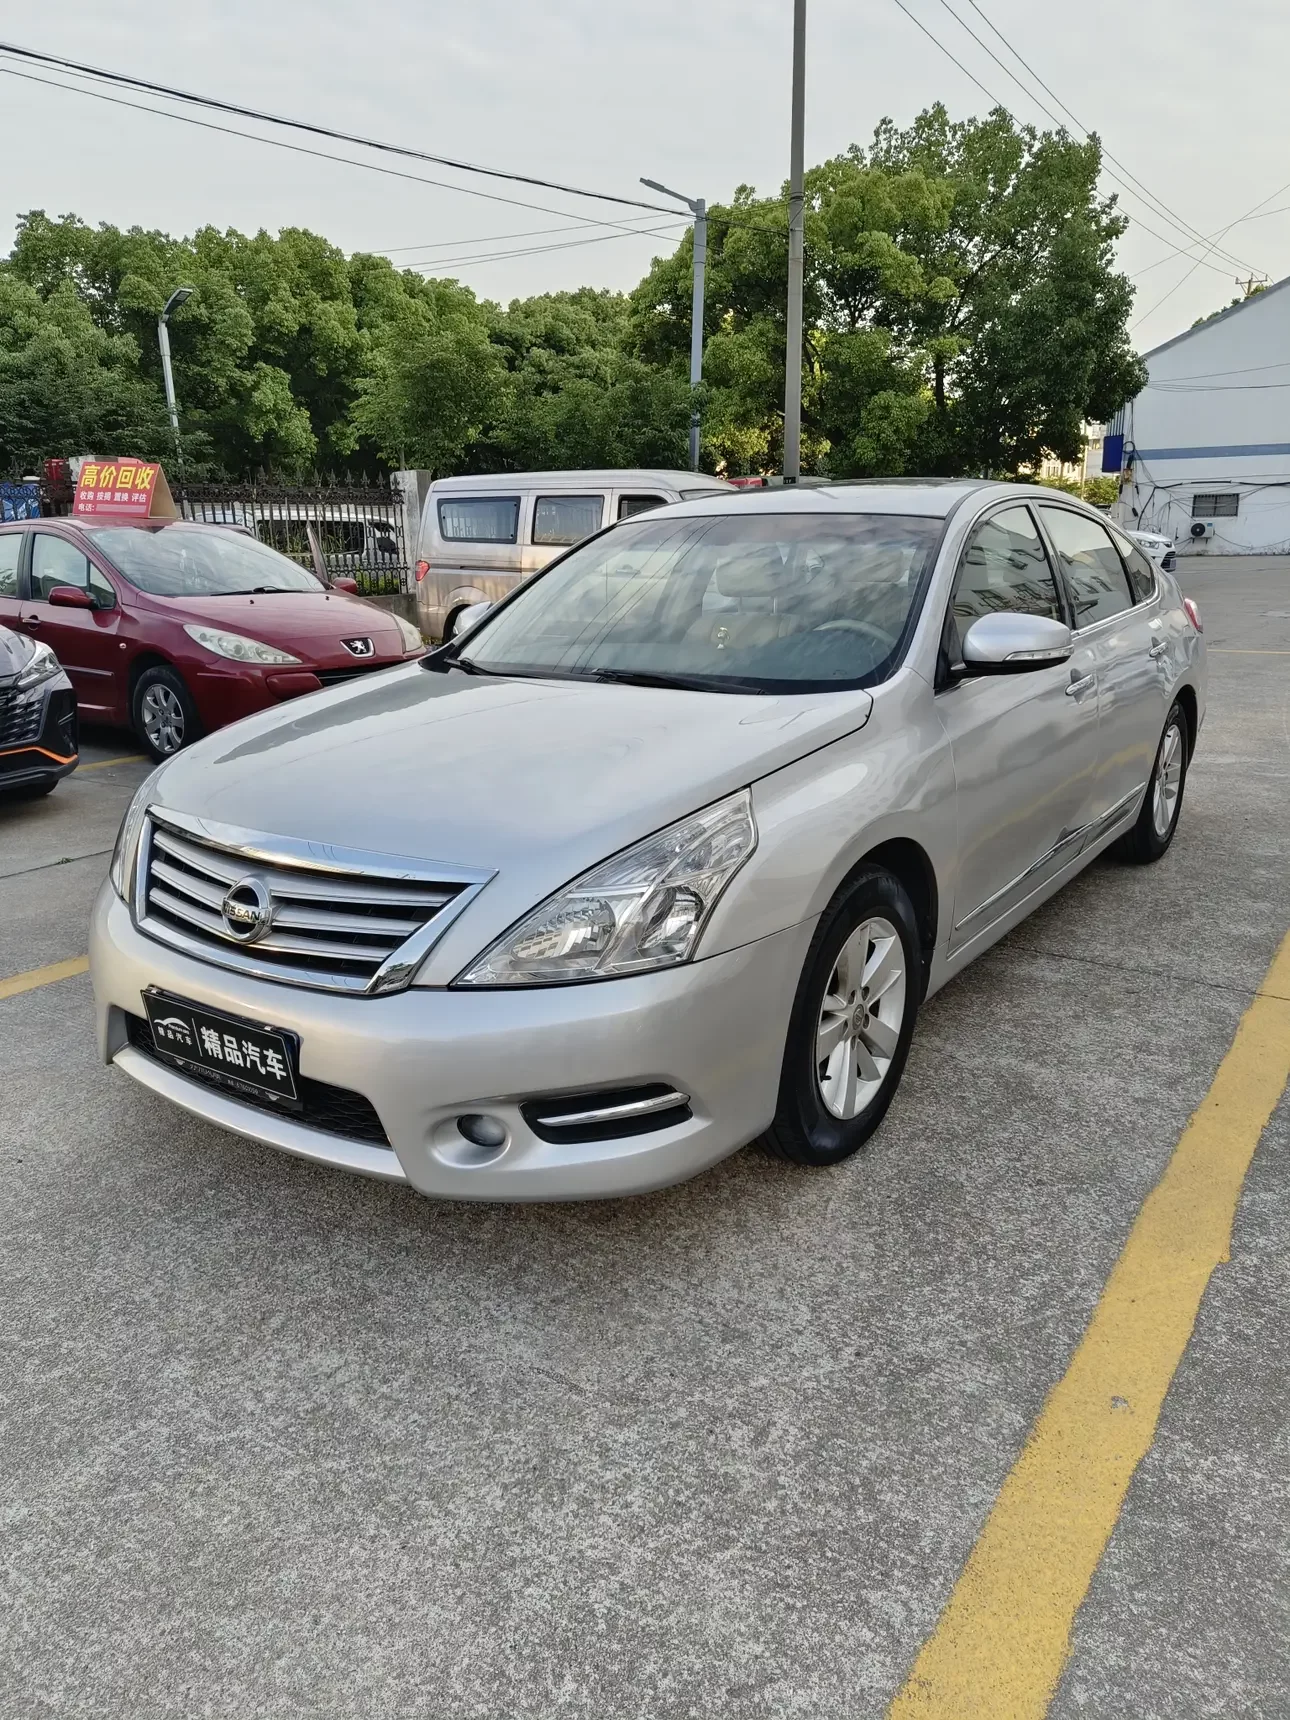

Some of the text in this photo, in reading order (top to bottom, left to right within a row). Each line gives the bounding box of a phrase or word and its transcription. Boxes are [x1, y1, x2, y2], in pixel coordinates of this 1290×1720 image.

[81, 465, 154, 489] 高价回收
[80, 491, 95, 501] 收购
[114, 492, 129, 502] 置换
[132, 493, 147, 502] 评估
[223, 901, 262, 921] NISSAN
[200, 1026, 287, 1081] 精品汽车
